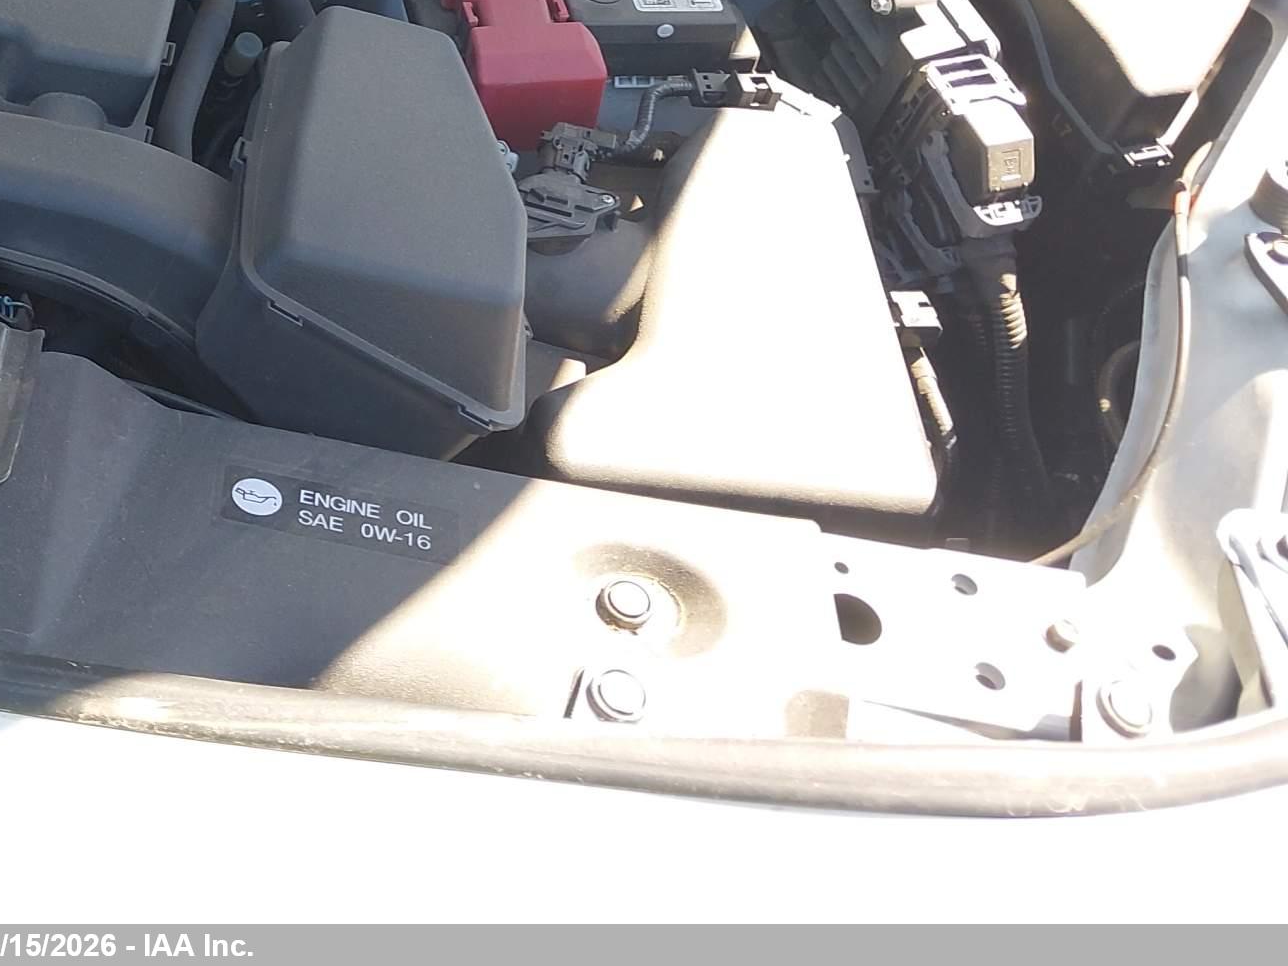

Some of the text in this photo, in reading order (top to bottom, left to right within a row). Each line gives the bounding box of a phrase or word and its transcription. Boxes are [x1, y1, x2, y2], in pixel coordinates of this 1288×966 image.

[299, 489, 433, 530] ENGINE OIL
[298, 510, 432, 550] SAE 0W-16
